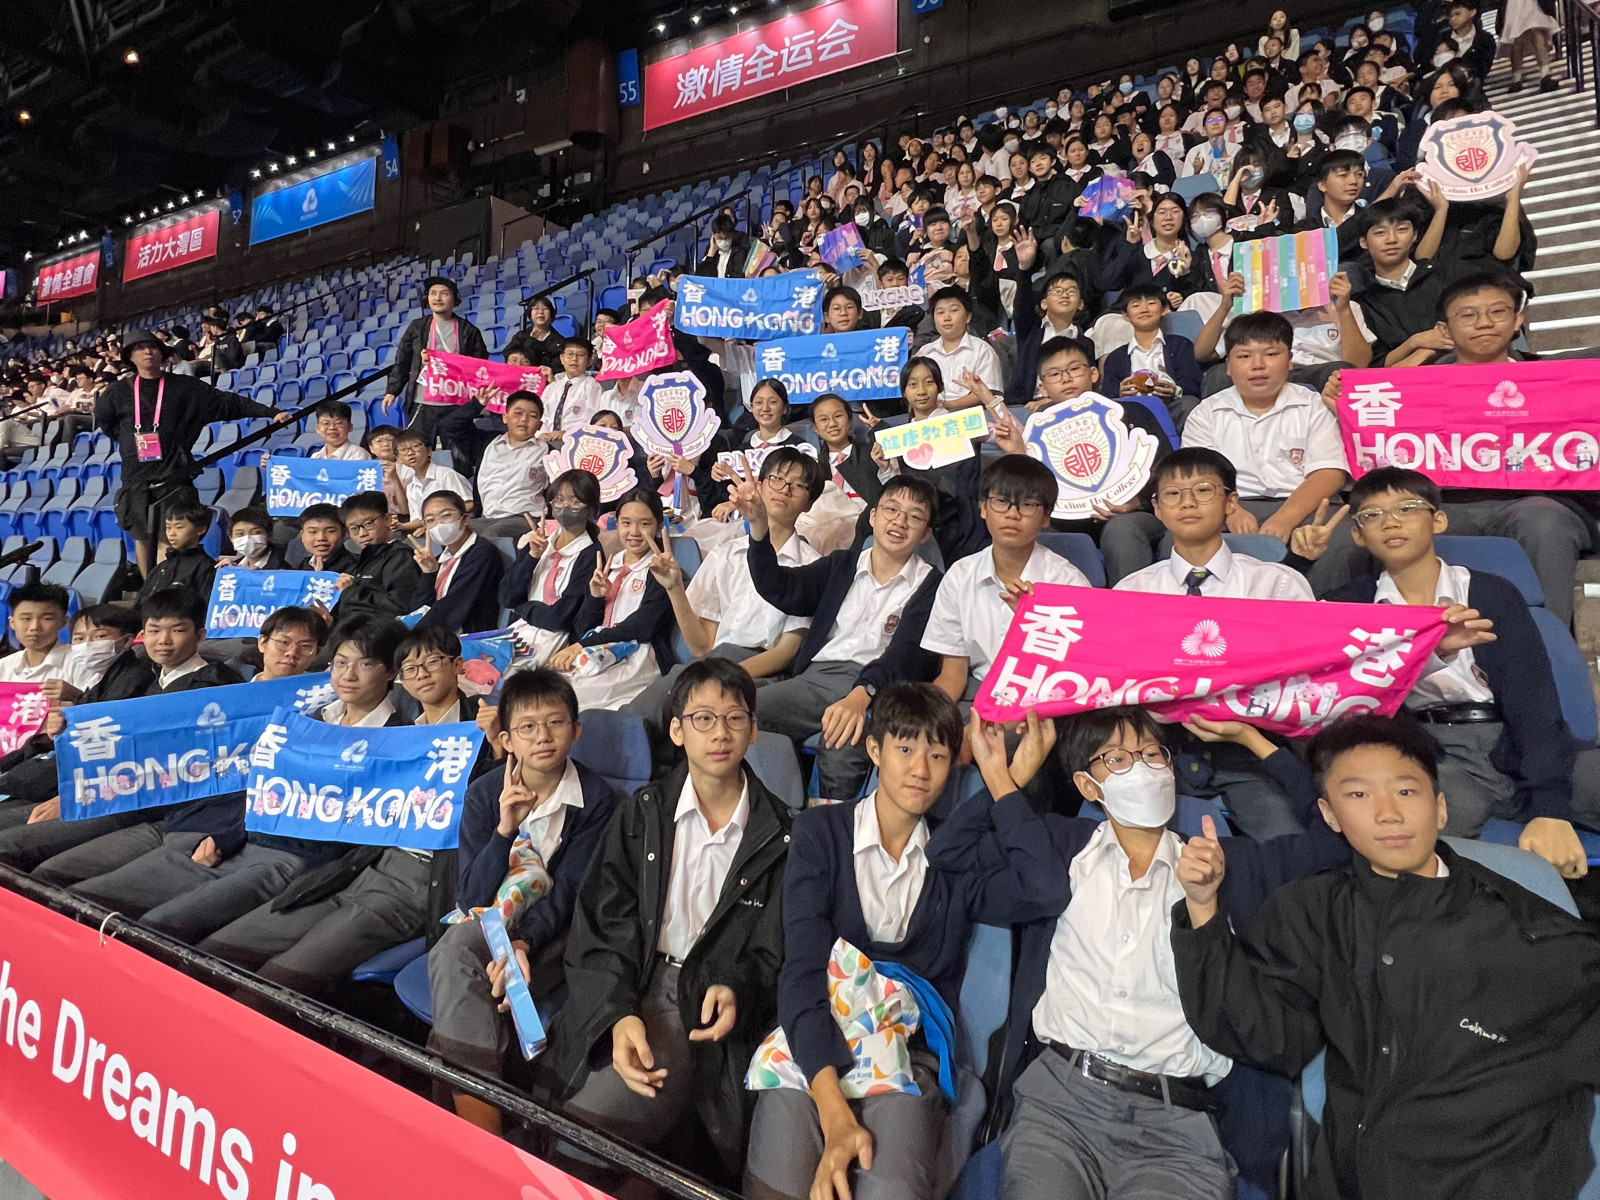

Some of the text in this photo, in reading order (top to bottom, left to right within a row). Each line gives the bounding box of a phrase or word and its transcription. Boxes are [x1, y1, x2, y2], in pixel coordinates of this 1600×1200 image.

[673, 18, 859, 109] 激情全运会
[619, 79, 637, 104] 55
[385, 158, 398, 178] 54
[137, 226, 205, 270] 活力大灣區
[683, 281, 818, 309] 香 港
[680, 305, 815, 334] HONG KONG
[762, 336, 900, 372] 香 港
[829, 364, 900, 391] KONG
[1348, 382, 1403, 427] 香
[881, 413, 983, 452] 健康教育週
[1352, 432, 1500, 473] HONG
[270, 465, 378, 491] 香 港
[1055, 502, 1088, 510] Celine
[1106, 473, 1137, 500] College
[269, 488, 322, 509] HONG
[218, 573, 335, 608] 香 港
[1019, 604, 1417, 688] 香 港
[990, 655, 1180, 708] HONG
[8, 692, 48, 725] 港
[70, 715, 122, 763] 香
[250, 724, 288, 770] 香
[424, 736, 473, 784] 港
[73, 749, 211, 805] HONG
[247, 774, 455, 831] HONG KONG
[52, 998, 253, 1200] Dreams
